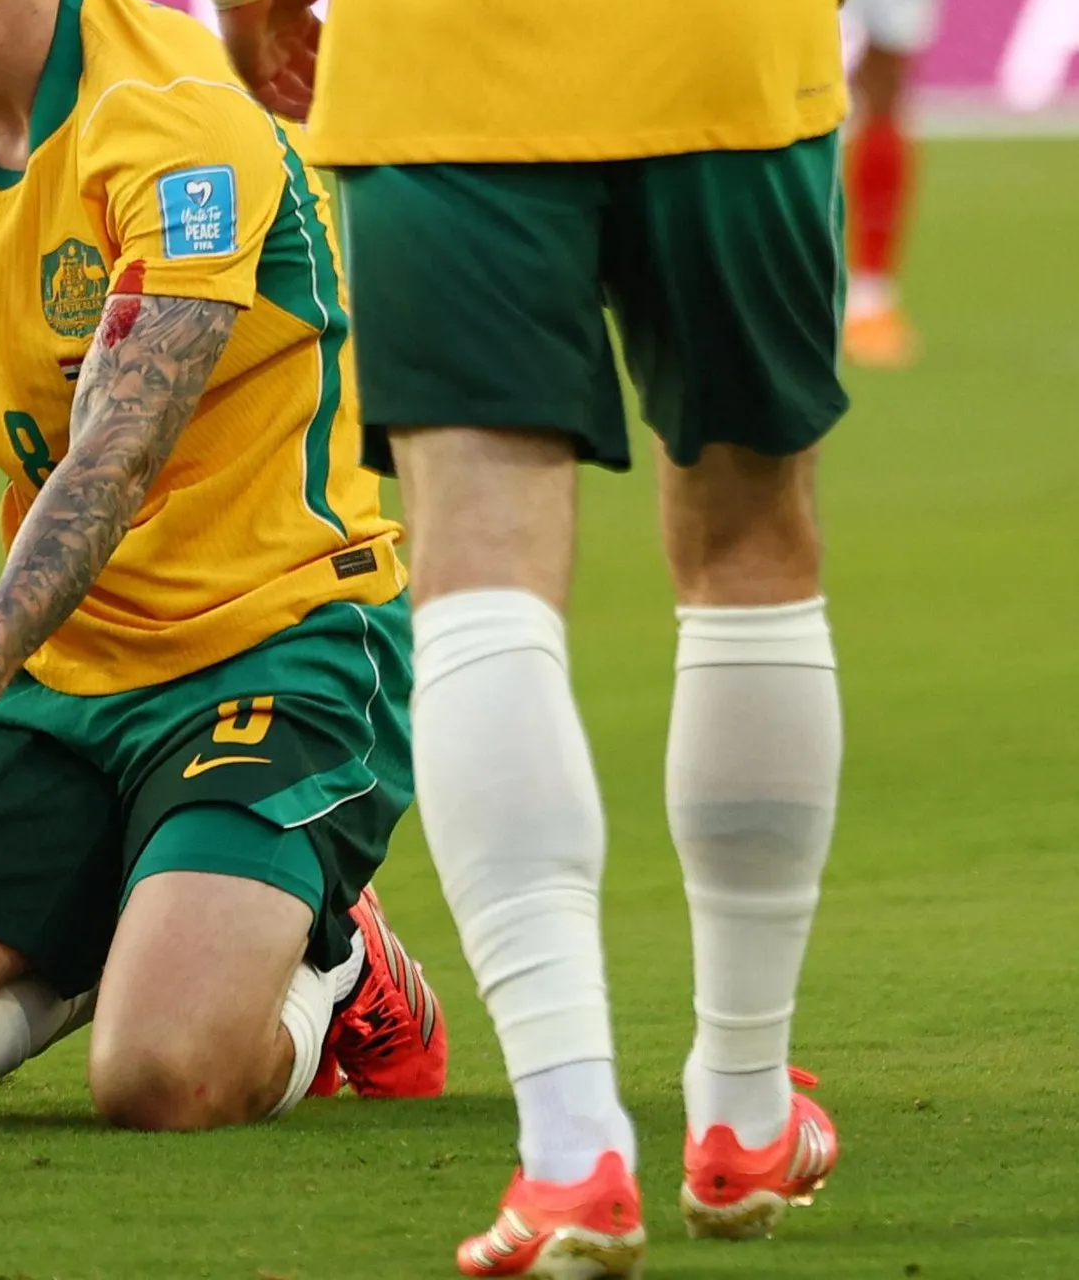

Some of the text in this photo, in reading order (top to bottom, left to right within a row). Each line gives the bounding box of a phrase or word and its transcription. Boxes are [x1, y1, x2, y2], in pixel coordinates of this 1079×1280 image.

[185, 223, 221, 241] PEACE
[193, 241, 214, 251] FIFA
[4, 411, 57, 489] 8
